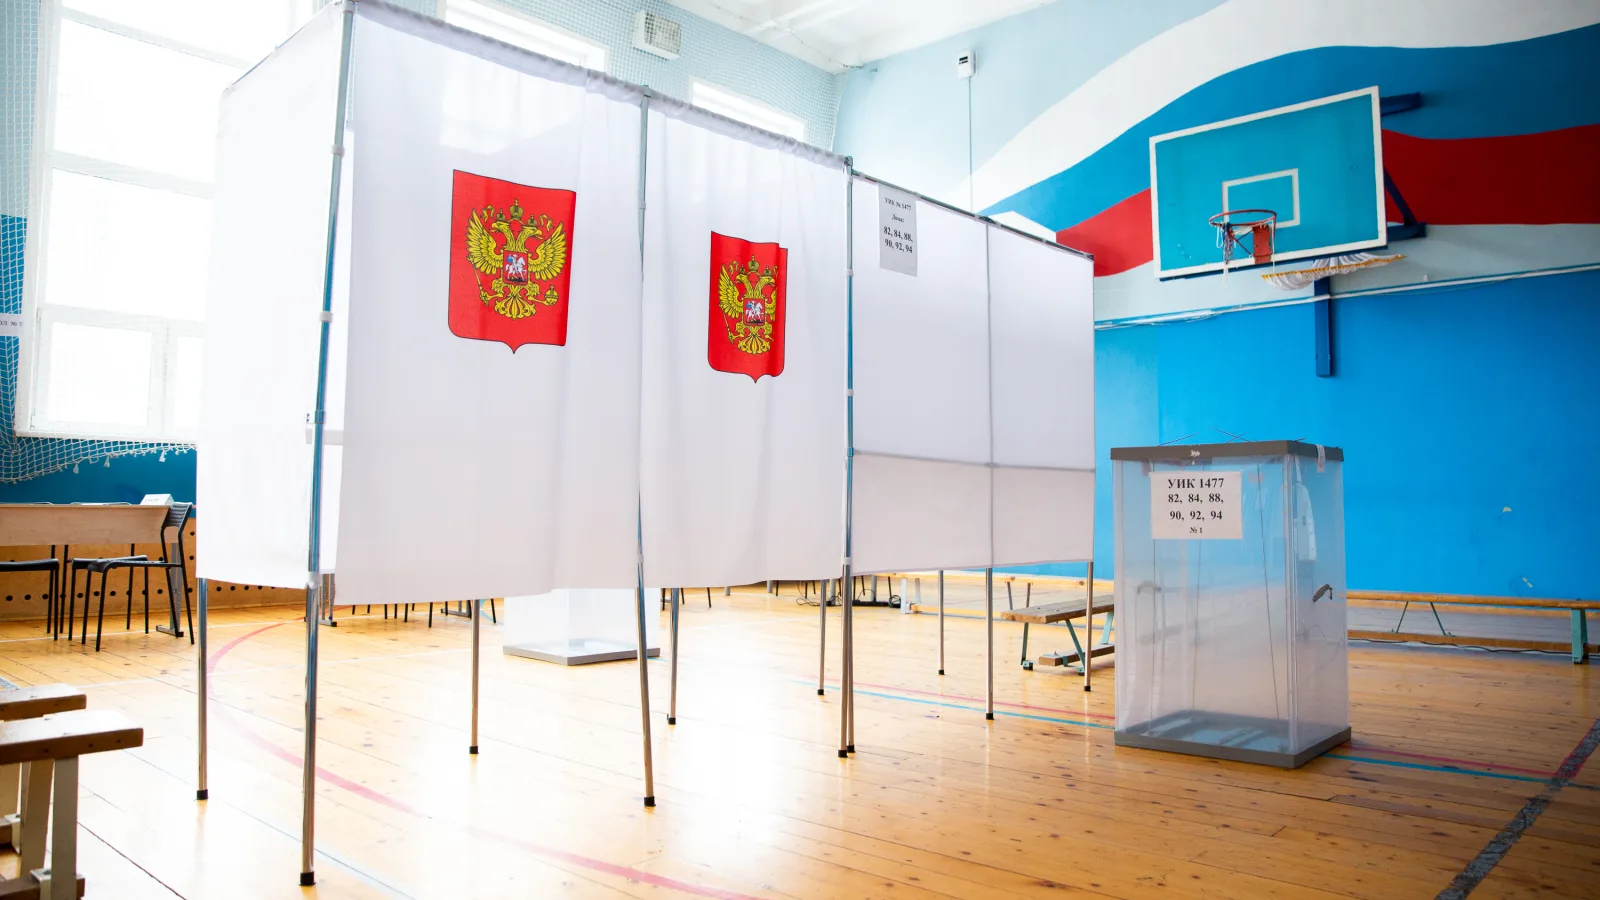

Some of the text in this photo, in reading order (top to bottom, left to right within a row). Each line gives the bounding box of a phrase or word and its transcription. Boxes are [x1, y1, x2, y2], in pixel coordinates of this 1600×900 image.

[883, 225, 914, 243] 82, 84, 88,
[884, 238, 913, 254] 90, 92, 94
[1168, 478, 1224, 489] УИК 1477
[1168, 493, 1224, 504] 82, 84, 88,
[1169, 510, 1223, 521] 90, 92, 94
